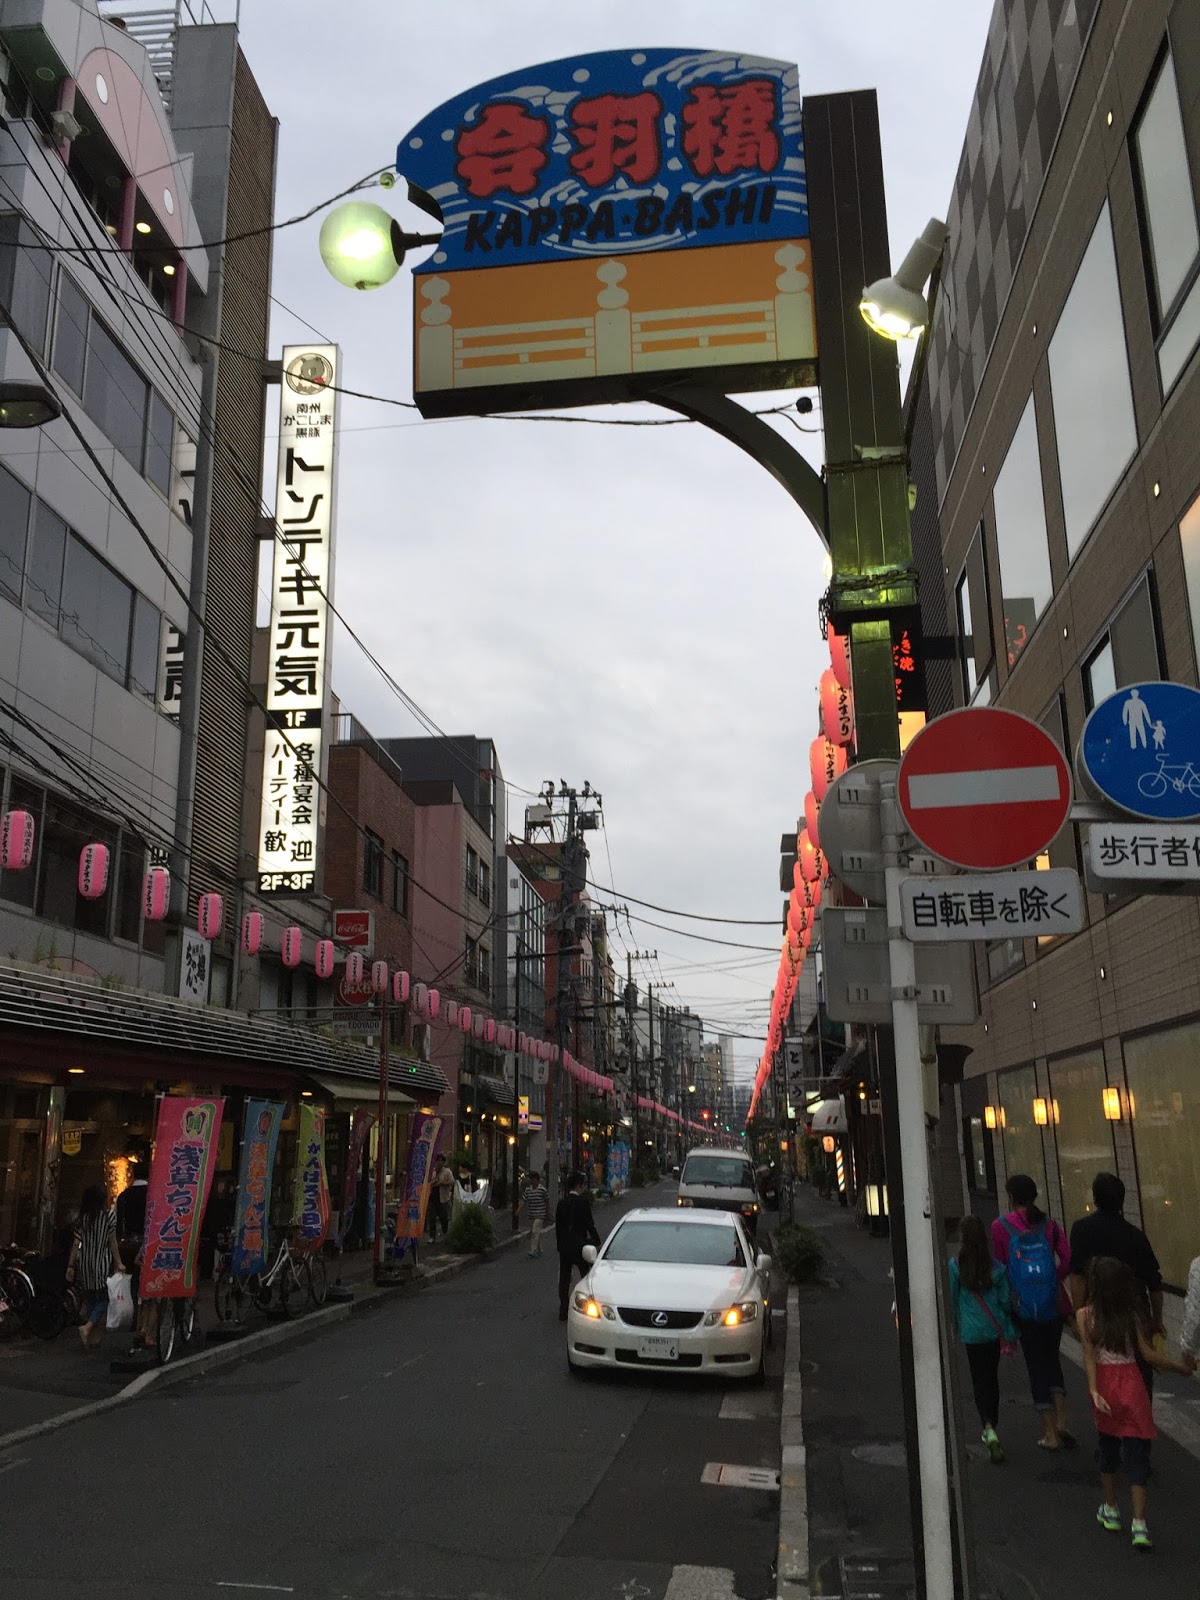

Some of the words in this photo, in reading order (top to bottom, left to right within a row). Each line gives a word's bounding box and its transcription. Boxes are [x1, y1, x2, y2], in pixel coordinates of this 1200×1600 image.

[455, 79, 780, 197] 合羽橋
[274, 447, 325, 696] トンテキ元気
[285, 712, 306, 728] 1F
[292, 742, 316, 825] 各種宴会
[912, 885, 1071, 927] 自転車を除く
